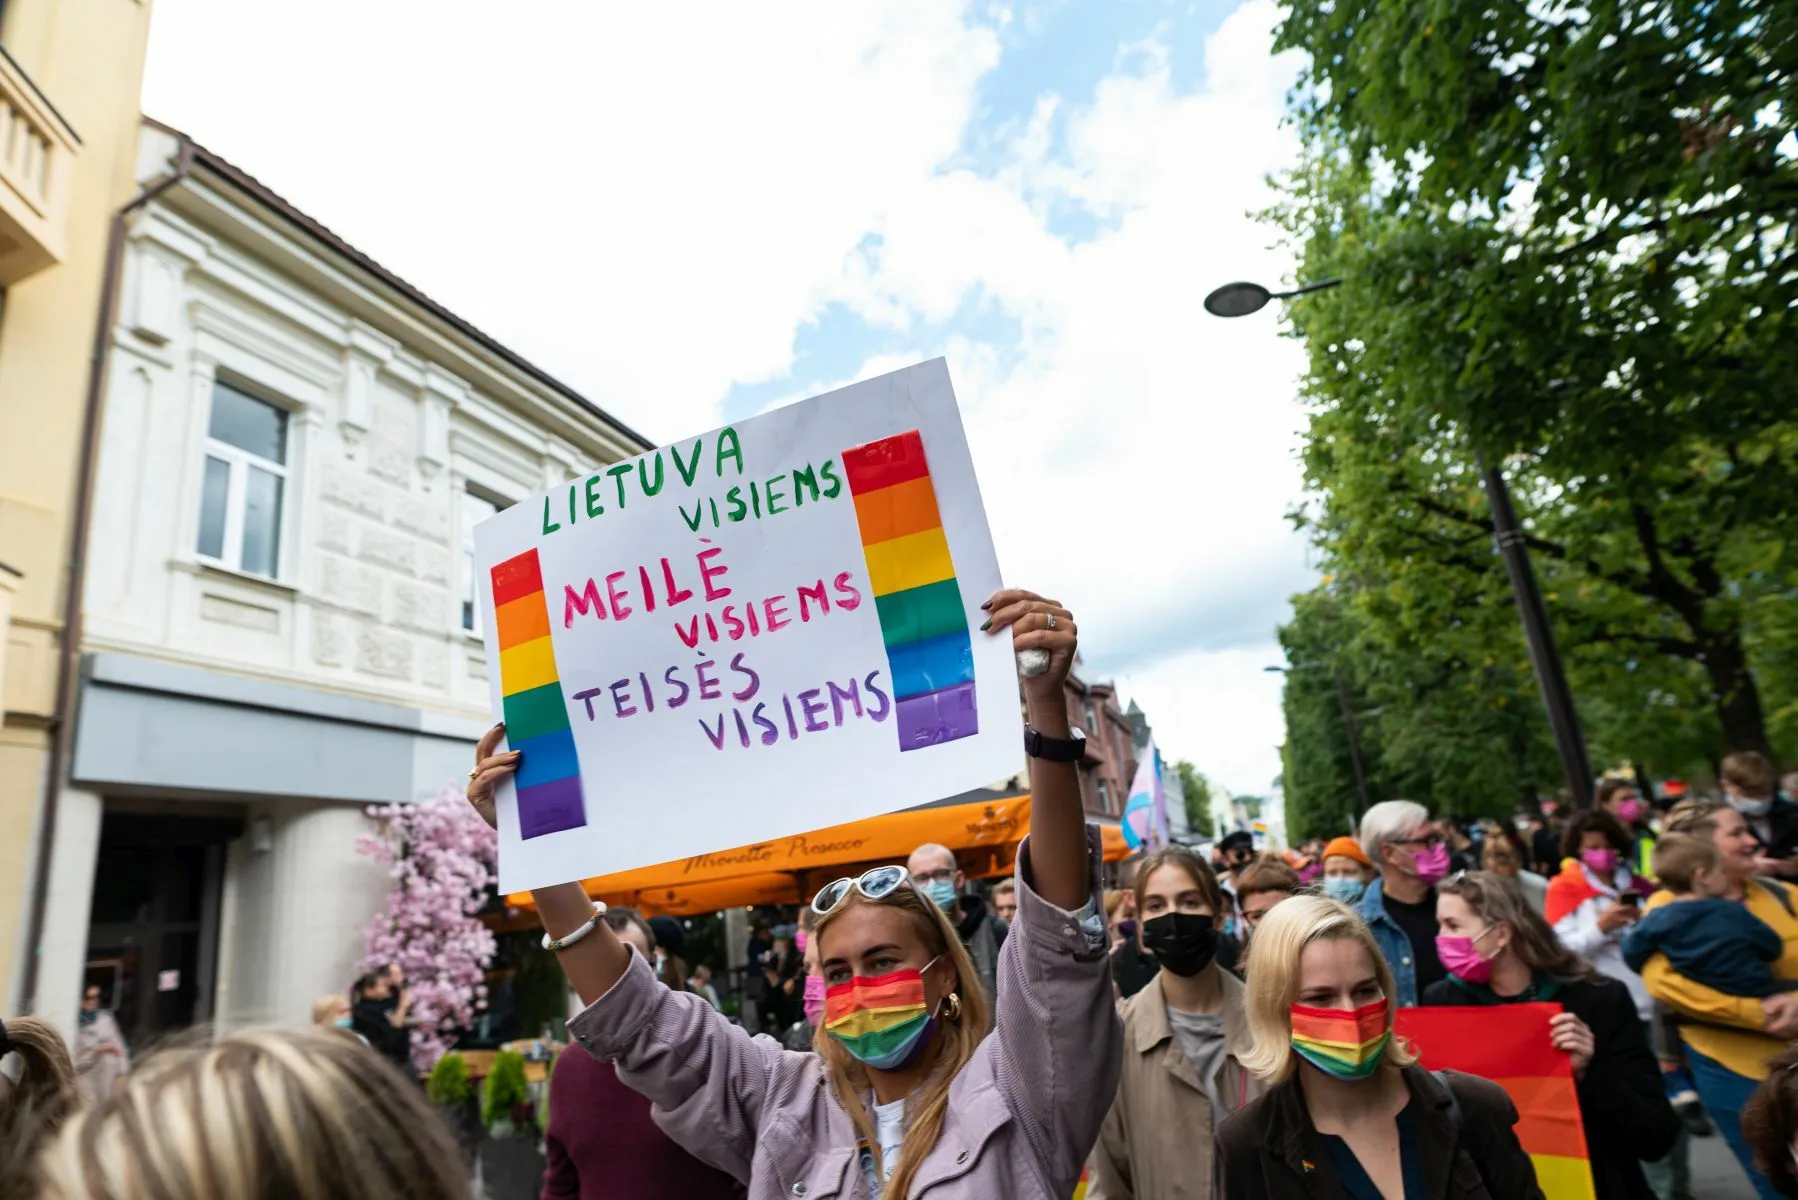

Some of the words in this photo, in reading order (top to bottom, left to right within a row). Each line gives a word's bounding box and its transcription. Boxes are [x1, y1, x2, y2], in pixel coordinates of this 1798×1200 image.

[542, 426, 744, 536] LIETUVA
[678, 459, 841, 532] VISIEMS
[674, 571, 862, 649] VISIEMS
[699, 671, 890, 750] VISIEMS
